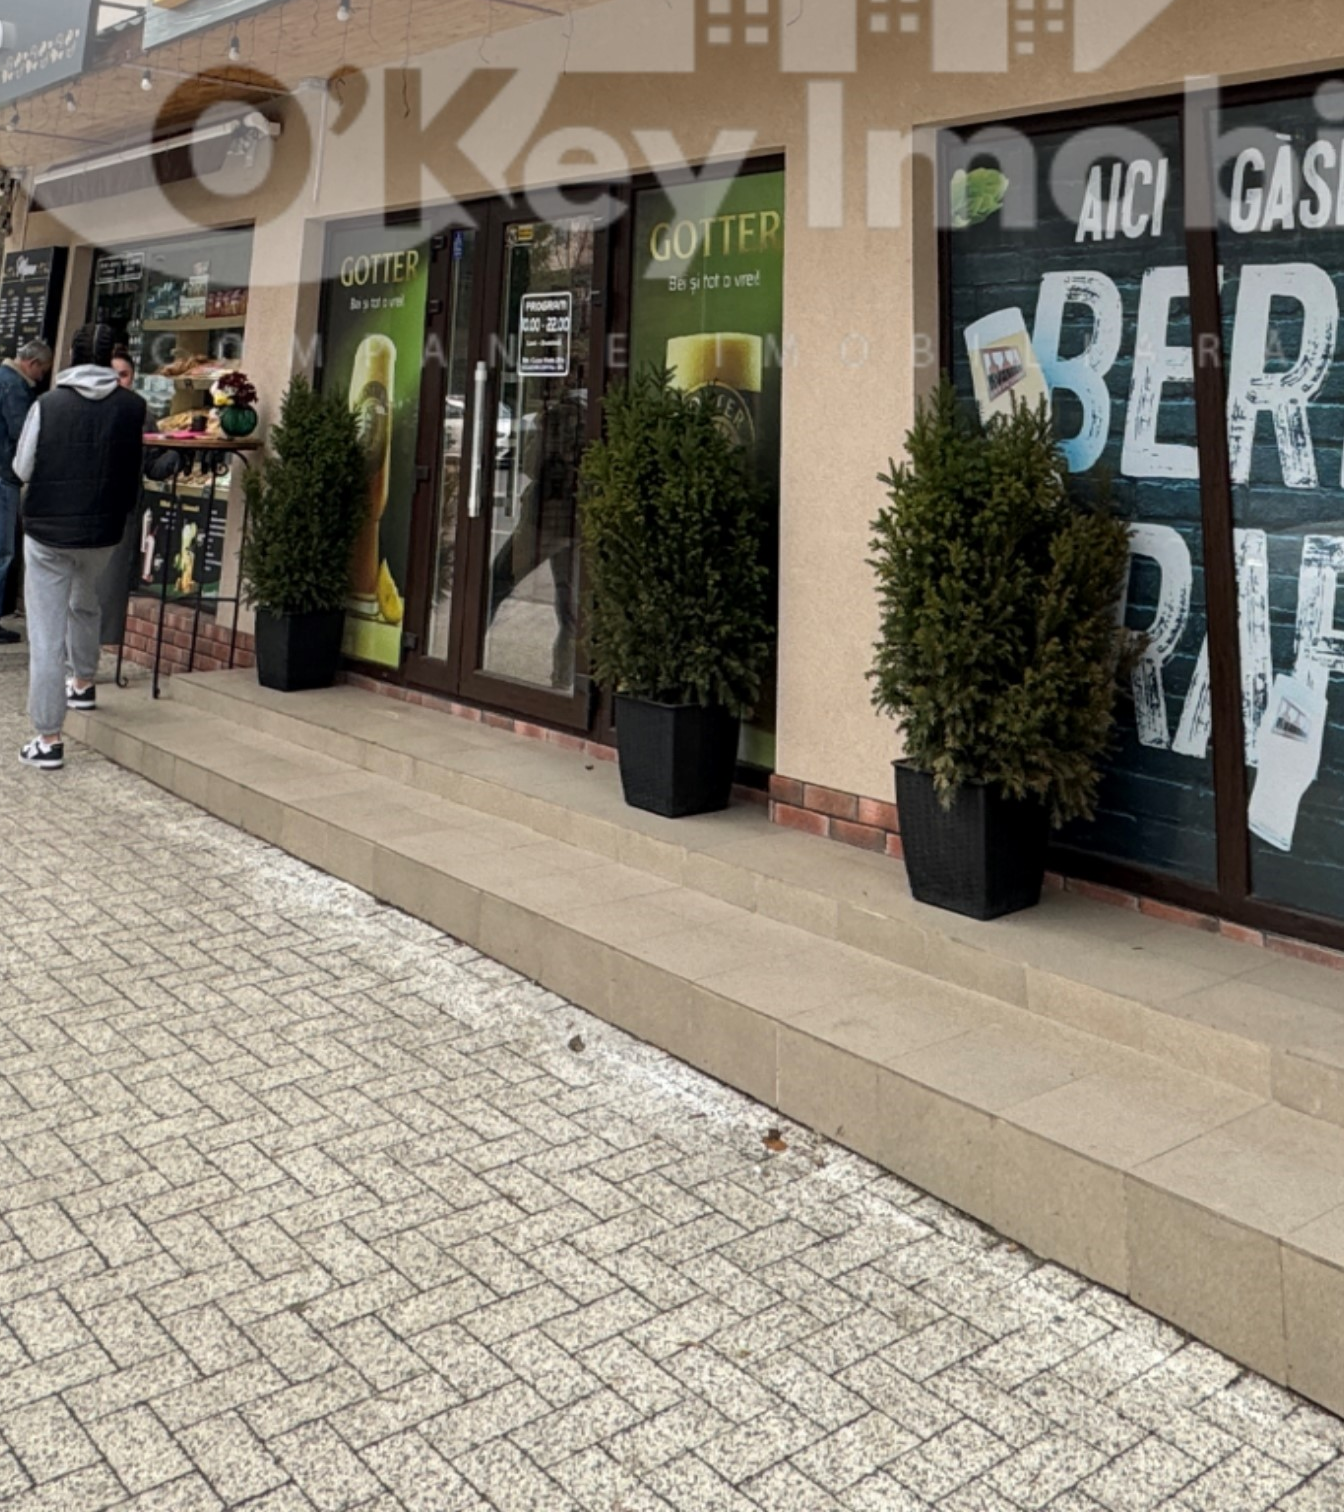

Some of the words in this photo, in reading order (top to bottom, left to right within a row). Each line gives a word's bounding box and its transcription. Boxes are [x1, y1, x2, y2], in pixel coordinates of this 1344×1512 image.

[1075, 158, 1167, 243] AICI
[650, 210, 783, 262] GOTTER
[340, 250, 419, 287] GOTTER
[668, 274, 687, 292] Bei
[526, 300, 567, 312] PROGRAM
